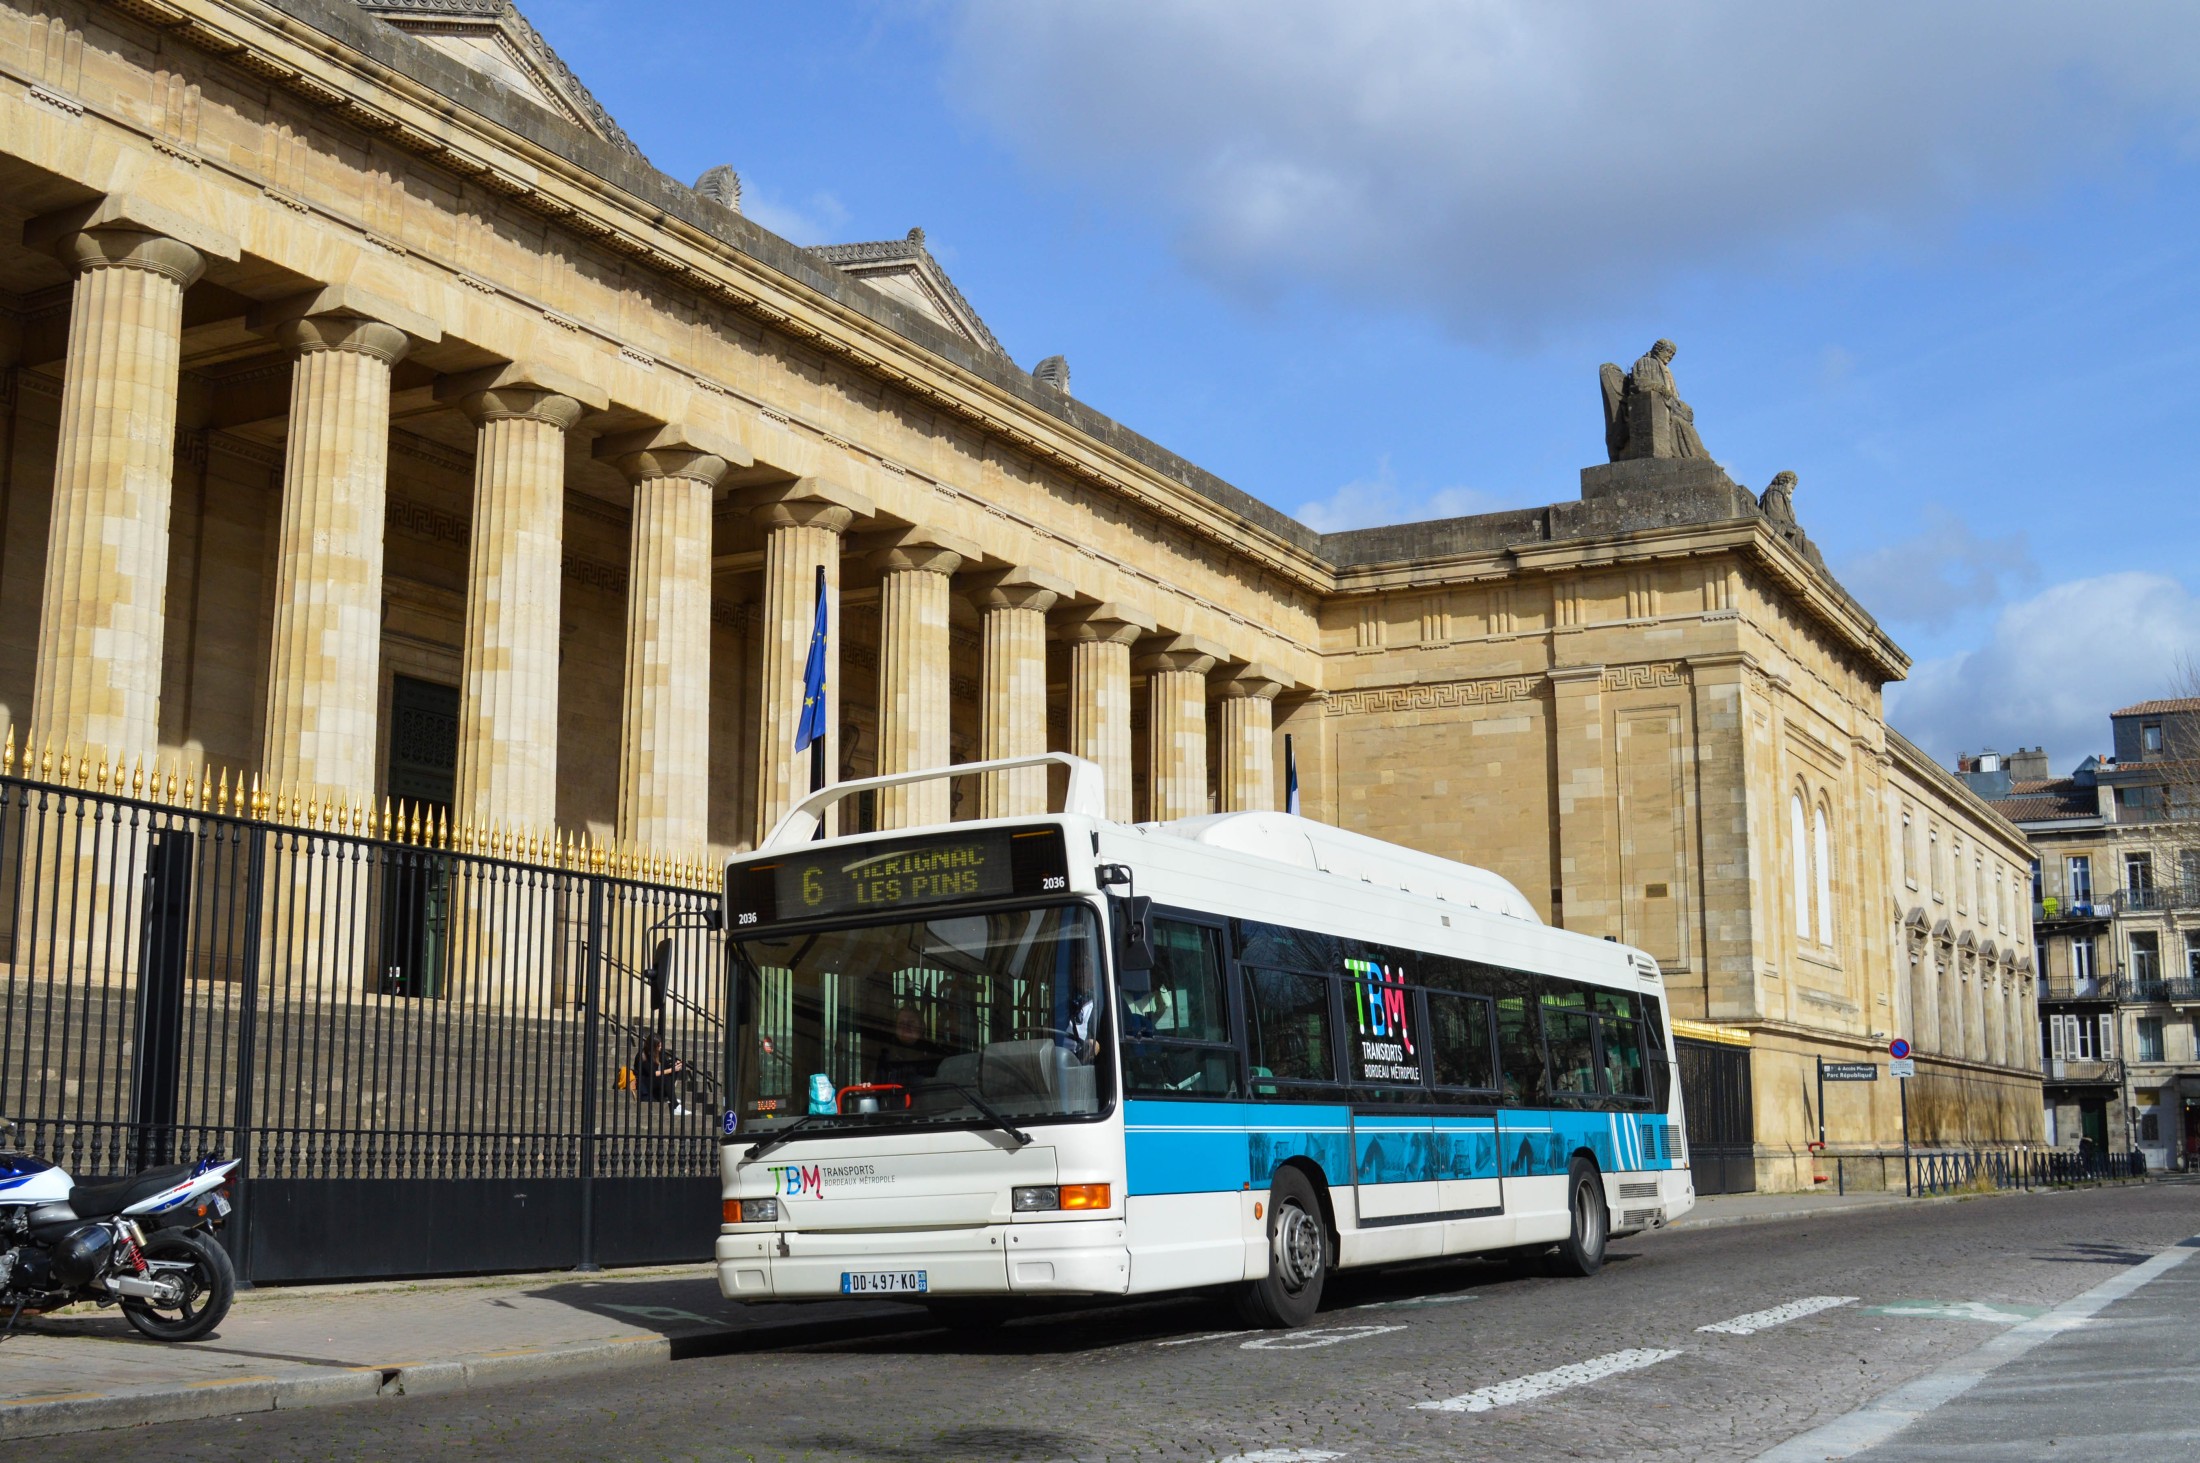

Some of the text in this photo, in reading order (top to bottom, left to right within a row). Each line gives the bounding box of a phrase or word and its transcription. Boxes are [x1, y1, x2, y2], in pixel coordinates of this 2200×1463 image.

[802, 866, 823, 906] 6
[857, 869, 978, 904] LES PINS
[1042, 876, 1065, 890] 2036
[738, 912, 758, 925] 2036
[1344, 958, 1414, 1055] TBM
[1390, 1063, 1420, 1080] MÉTROPOLE
[1840, 1071, 1873, 1080] République
[822, 1164, 875, 1178] TRANSPORTS
[767, 1164, 824, 1200] TBM
[824, 1175, 896, 1187] BORDEAUX MÉTROPOLE
